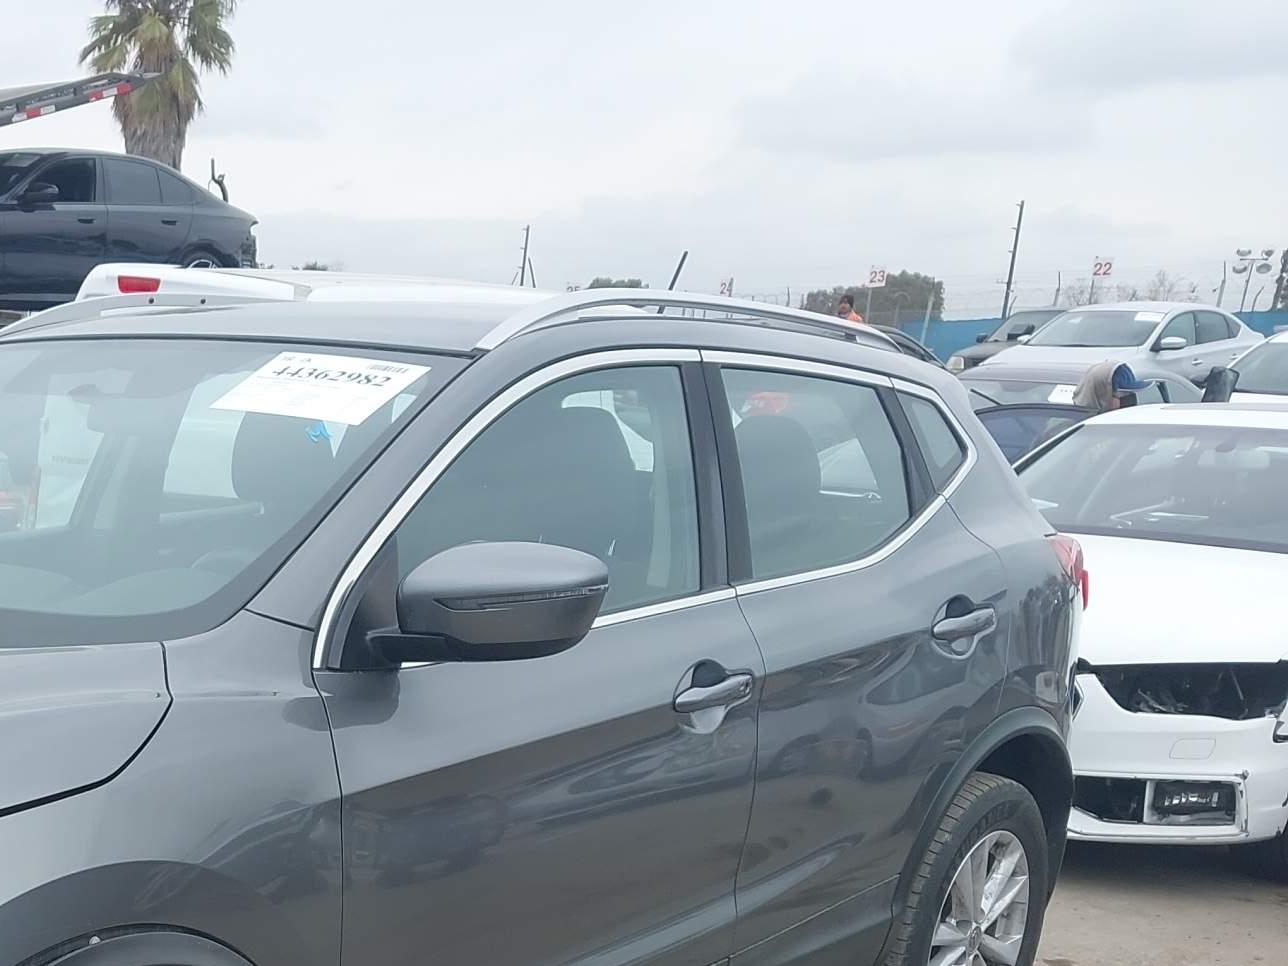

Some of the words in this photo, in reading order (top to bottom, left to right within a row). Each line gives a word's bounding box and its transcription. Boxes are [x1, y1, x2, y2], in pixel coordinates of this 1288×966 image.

[1093, 262, 1113, 276] 22
[869, 270, 886, 284] 23
[272, 365, 392, 387] 44362982
